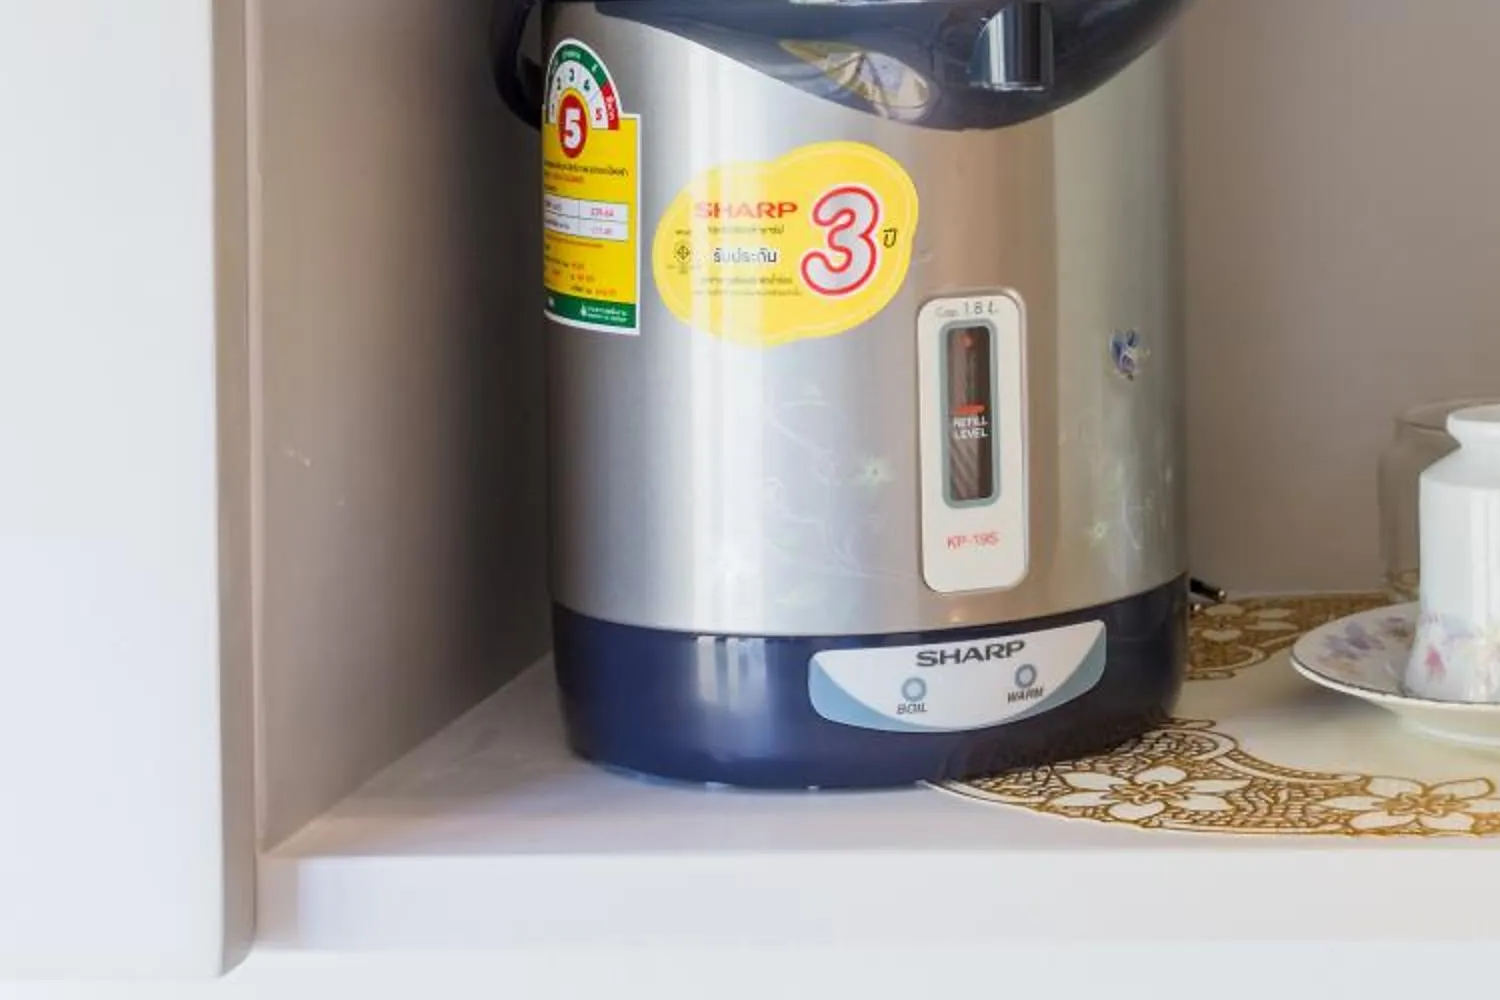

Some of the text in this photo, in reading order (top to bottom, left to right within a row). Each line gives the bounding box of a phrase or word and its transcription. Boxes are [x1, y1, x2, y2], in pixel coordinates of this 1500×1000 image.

[568, 67, 576, 82] 3
[594, 107, 603, 121] 5
[563, 108, 582, 149] 5
[695, 201, 799, 219] SHARP
[801, 186, 880, 296] 3
[953, 415, 989, 428] REFILL
[953, 427, 989, 440] LEVEL
[915, 640, 1026, 667] SHARP
[1007, 685, 1045, 703] WARM
[896, 702, 929, 715] BOIL
